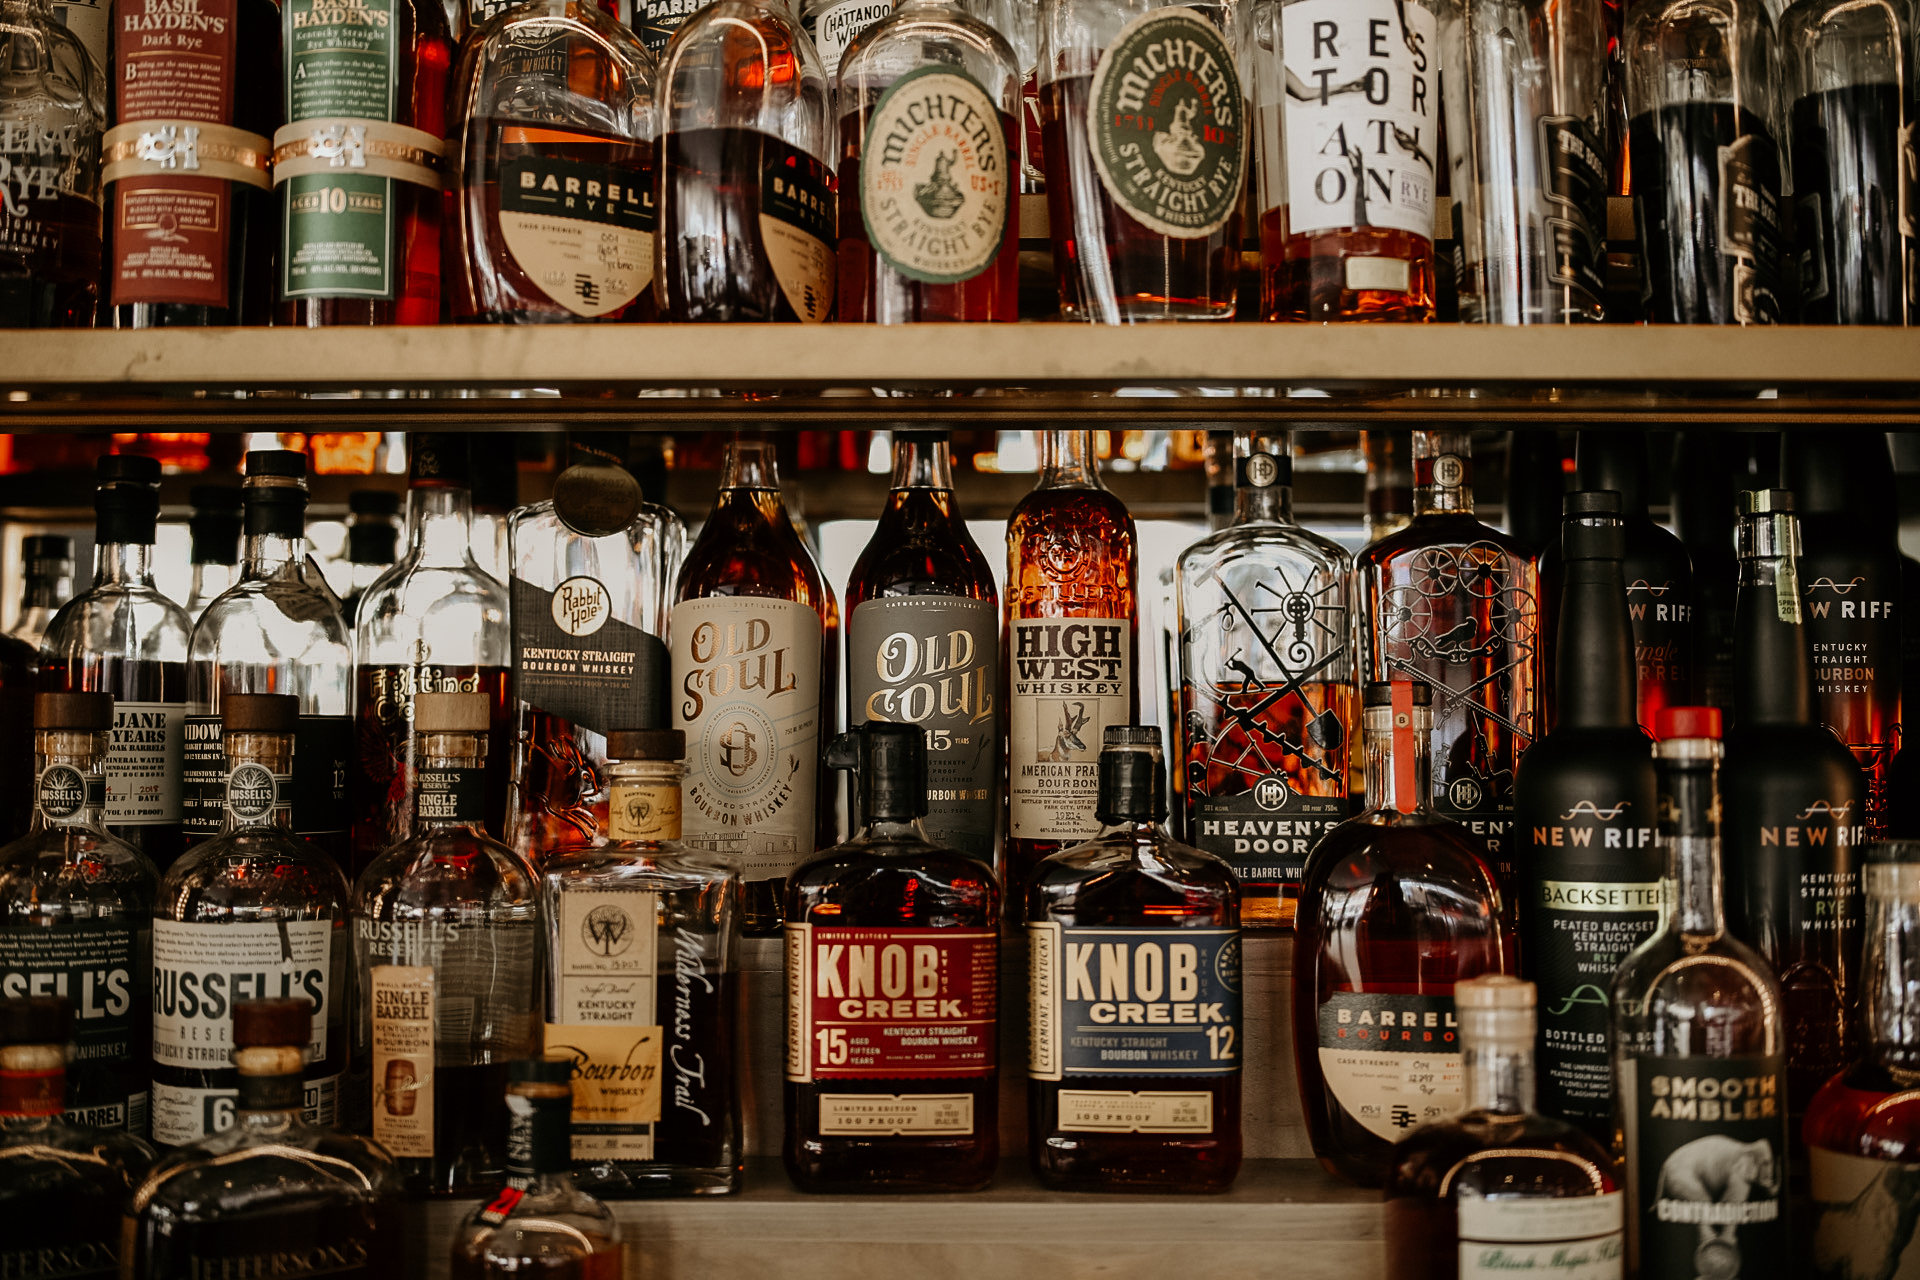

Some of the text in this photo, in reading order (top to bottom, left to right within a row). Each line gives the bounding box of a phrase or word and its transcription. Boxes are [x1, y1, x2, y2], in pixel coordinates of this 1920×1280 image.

[144, 0, 203, 15] BASIL
[312, 0, 368, 10] BASIL
[124, 13, 226, 34] HAYDEN'S
[293, 9, 389, 29] HAYDEN'S
[142, 32, 202, 50] Dark Rye
[296, 27, 385, 41] Kentucky Straight
[307, 38, 370, 50] Rye Whiskey
[1115, 38, 1233, 127] MICHTER'S
[882, 94, 996, 171] MICHTER'S
[1119, 142, 1233, 213] STRAIGHT RYE
[1154, 168, 1207, 193] KENTUCKY
[520, 171, 654, 208] BARRELL
[1401, 181, 1429, 204] RYE
[319, 186, 347, 214] 10
[565, 196, 614, 214] RYE
[1155, 205, 1206, 224] WHISKEY
[880, 197, 970, 255] STRAIGHT
[972, 202, 996, 239] RYE
[561, 586, 602, 617] Rabbit
[1841, 601, 1893, 618] RIFF
[571, 606, 598, 635] Hole
[690, 618, 771, 664] OLD
[1016, 624, 1122, 658] HIGH
[522, 647, 635, 663] KENTUCKY STRAIGHT
[876, 629, 975, 683] OLD
[522, 661, 634, 674] BOURBON WHISKEY
[1016, 658, 1122, 680] WEST
[682, 648, 797, 722] SOUL
[1016, 682, 1122, 694] WHISKEY
[114, 712, 166, 729] JANE
[112, 729, 165, 743] YEARS
[924, 729, 952, 751] 15
[333, 770, 346, 788] 12
[1021, 765, 1071, 777] AMERICAN
[1038, 779, 1097, 788] BOURBON
[41, 789, 83, 800] RUSSELL'S
[231, 789, 272, 800] RUSSELL'S
[418, 794, 457, 806] SINGLE
[699, 778, 782, 810] BLENDED STRAIGHT
[418, 806, 457, 817] BARREL
[689, 783, 793, 826] BOURBON WHISKEY
[1203, 820, 1339, 836] HEAVEN'S
[1534, 826, 1594, 848] NEW
[1760, 826, 1828, 847] NEW
[1234, 838, 1308, 854] DOOR
[1251, 867, 1283, 879] BARREL
[1801, 873, 1857, 884] KENTUCKY
[1801, 886, 1857, 898] STRAIGHT
[1816, 901, 1845, 915] RYE
[359, 920, 460, 942] RUSSELL'S
[1553, 919, 1655, 933] PEATED BACKSET
[1801, 919, 1857, 931] WHISKEY
[1572, 932, 1637, 942] KENTUCKY
[1574, 942, 1635, 953] STRAIGHT
[1593, 953, 1617, 963] RYE
[816, 943, 939, 998] KNOB
[1064, 942, 1199, 1002] KNOB
[375, 991, 429, 1006] SINGLE
[577, 1000, 636, 1010] KENTUCKY
[789, 934, 801, 1069] CLERMONT, KENTUCKY
[1039, 935, 1050, 1068] CLERMONT, KENTUCKY
[376, 1006, 430, 1020] BARREL
[579, 1011, 633, 1021] STRAIGHT
[838, 999, 964, 1019] CREEK
[1089, 1002, 1224, 1024] CREEK
[670, 926, 714, 1127] Wilderness Trail
[883, 1026, 968, 1037] KENTUCKY STRAIGHT
[850, 1037, 870, 1046] AGED
[901, 1035, 979, 1046] BOURBON WHISKEY
[1070, 1037, 1168, 1048] KENTUCKY STRAIGHT
[1205, 1025, 1235, 1061] 12
[1545, 1028, 1605, 1044] BOTTLED
[76, 1042, 128, 1059] WHISKEY
[815, 1028, 848, 1065] 15
[850, 1047, 881, 1055] FIFTEEN
[850, 1057, 875, 1065] YEARS
[1100, 1050, 1199, 1061] BOURBON WHISKEY
[1337, 1057, 1399, 1067] CASK STRENGTH
[600, 1087, 646, 1096] WHISKEY
[1650, 1075, 1777, 1099] SMOOTH
[213, 1098, 234, 1133] 6
[833, 1104, 917, 1113] LIMITED EDITION
[1076, 1112, 1152, 1121] 100 PROOF
[1650, 1097, 1778, 1121] AMBLER
[838, 1116, 914, 1125] 100 PROOF
